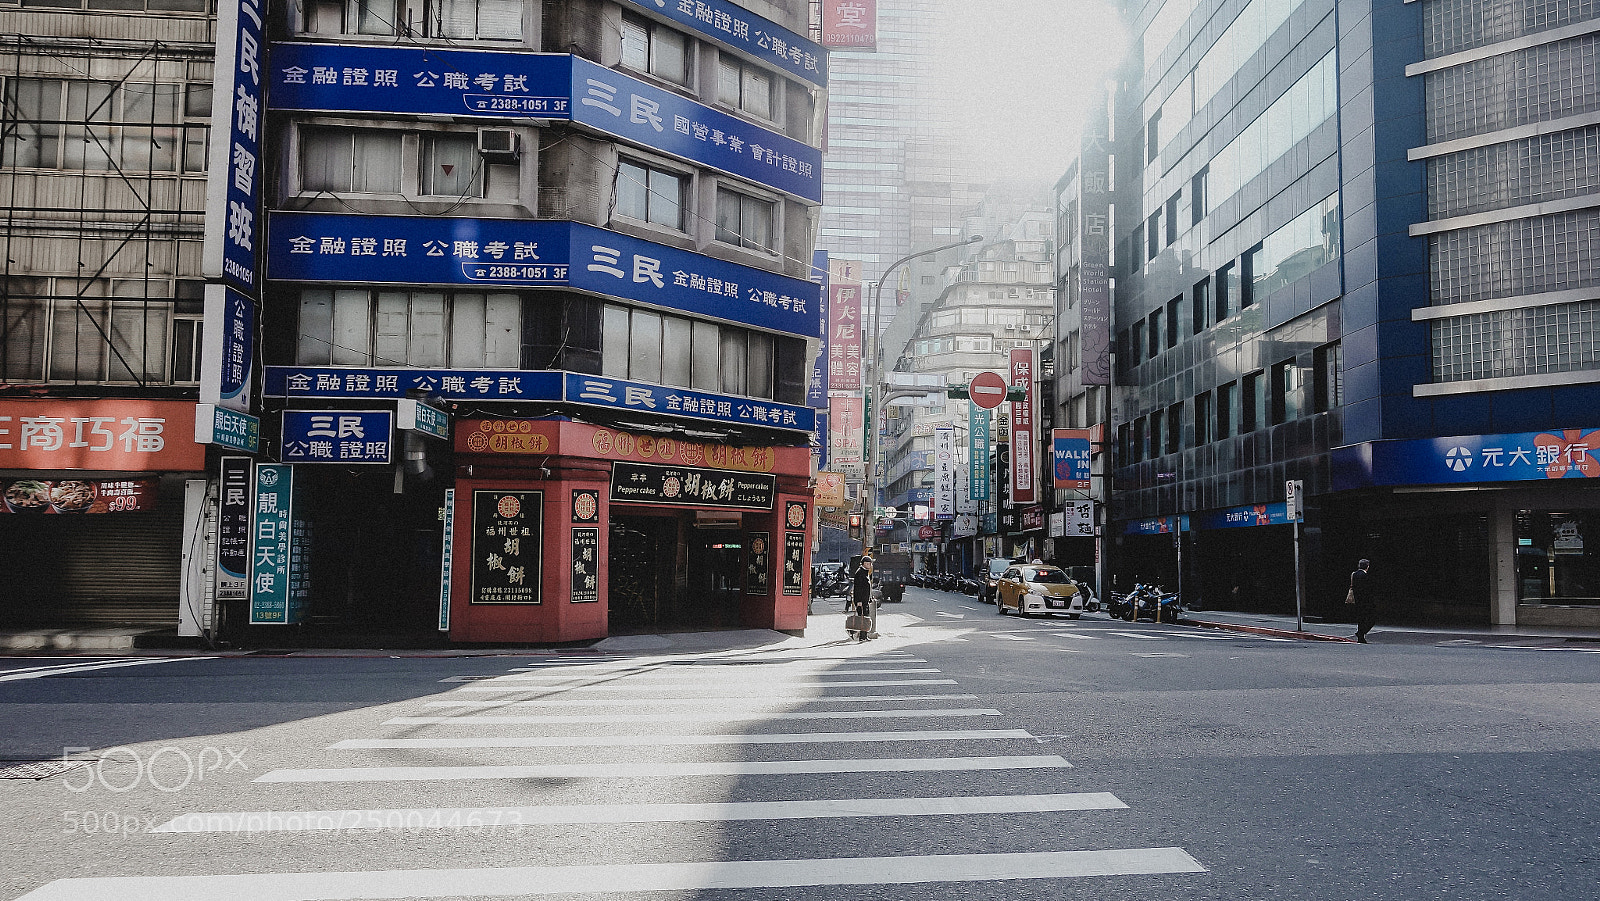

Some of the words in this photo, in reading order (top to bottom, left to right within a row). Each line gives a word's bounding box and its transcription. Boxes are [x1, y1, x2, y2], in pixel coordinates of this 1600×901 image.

[835, 1, 867, 28] 堂
[755, 30, 820, 74] 公職考試
[282, 65, 398, 88] 金融證照
[413, 71, 529, 93] 公職考試
[491, 98, 547, 111] 2388-1051
[554, 99, 567, 111] 3F
[582, 78, 664, 132] 三民
[674, 114, 744, 153] 國營事業
[749, 144, 813, 179] 會計證照
[289, 235, 407, 257] 金融證照
[423, 240, 540, 261] 公職考試
[490, 266, 547, 279] 2388-1051
[554, 267, 567, 279] 3F
[587, 245, 664, 289] 三民
[672, 269, 739, 299] 金融證照
[748, 288, 807, 314] 公職考試
[288, 373, 399, 393] 金融證照
[413, 376, 523, 394] 公職考試
[580, 380, 657, 409] 三民
[666, 393, 732, 418] 金融證照
[737, 404, 798, 426] 公職考試
[307, 415, 365, 439] 三民
[285, 440, 333, 459] 公職
[339, 441, 387, 459] 證照
[495, 435, 543, 451] 胡椒餅
[834, 438, 857, 448] SPA
[1055, 450, 1090, 459] WALK
[1481, 443, 1589, 467] 元大銀行
[710, 444, 769, 471] 胡椒餅
[1077, 461, 1090, 469] IN
[226, 470, 246, 506] 三民
[617, 485, 639, 495] Pepper
[684, 472, 735, 501] 胡椒餅
[737, 482, 755, 491] Pepper
[255, 492, 278, 594] 靚白天使
[486, 537, 526, 586] 胡椒餅
